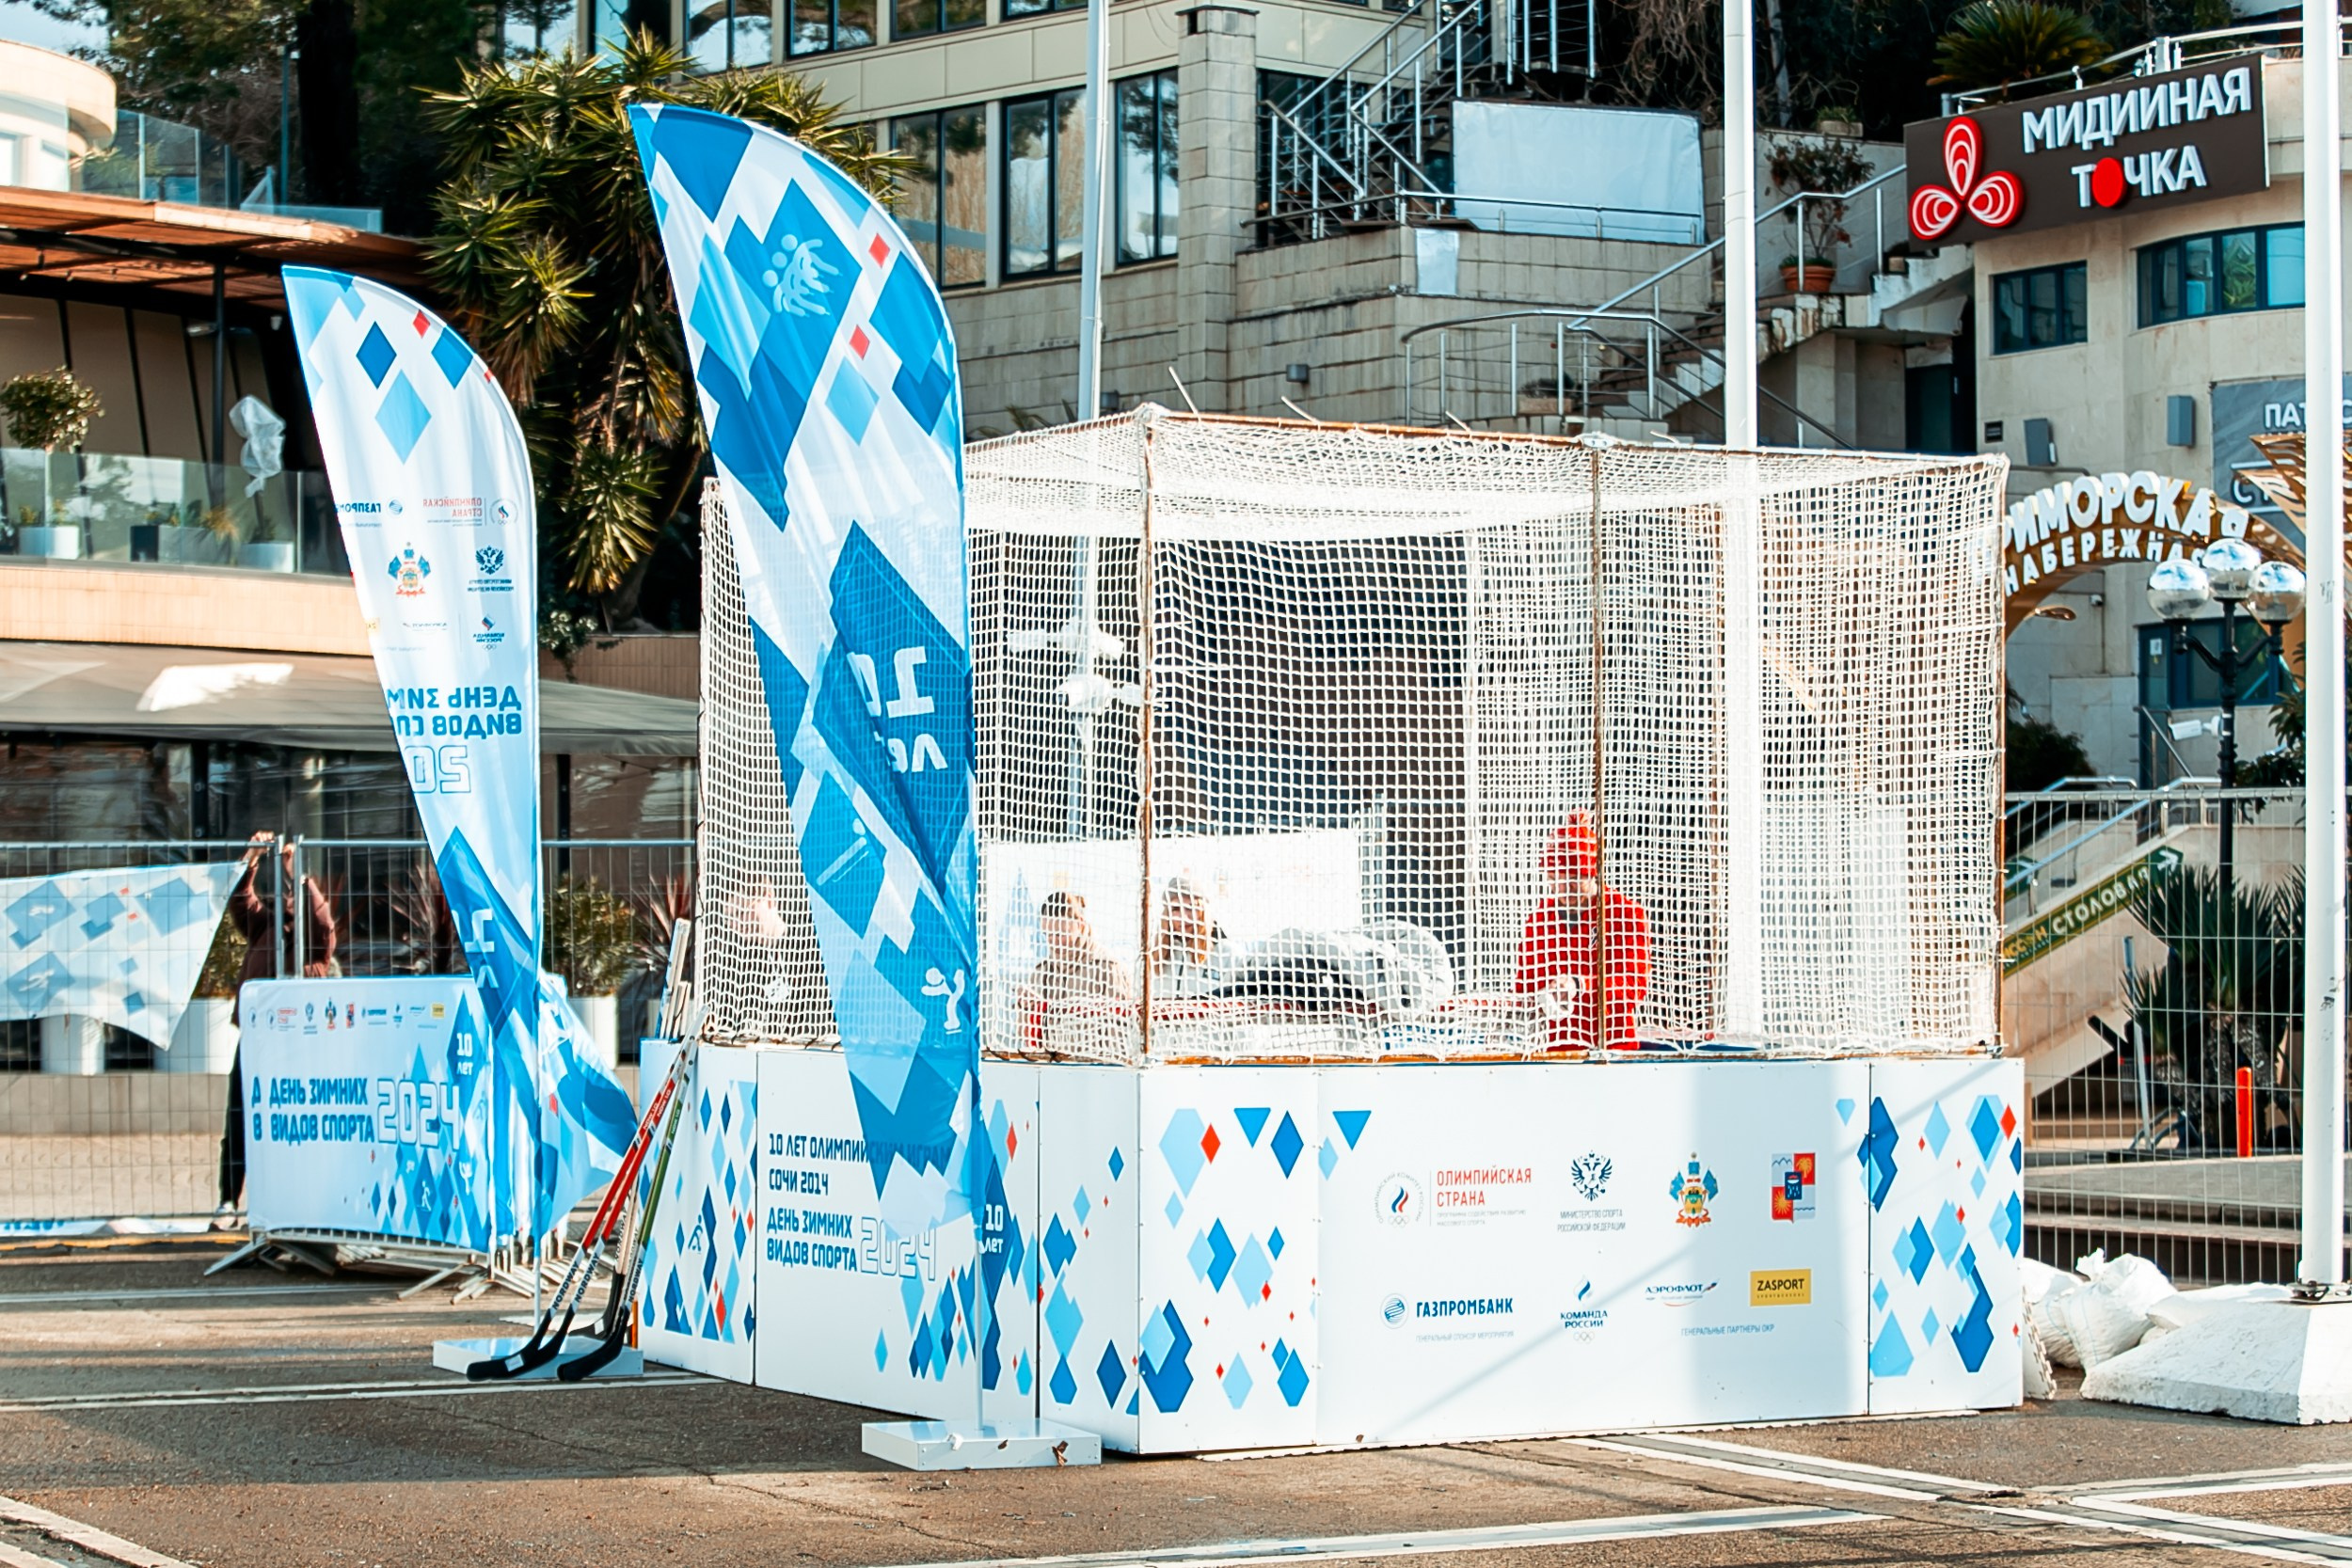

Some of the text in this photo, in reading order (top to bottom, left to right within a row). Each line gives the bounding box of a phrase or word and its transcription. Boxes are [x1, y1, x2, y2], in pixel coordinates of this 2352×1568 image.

[456, 1033, 472, 1057] 10
[269, 1078, 460, 1151] ДЕНЬ ЗИМНИХ 2024
[270, 1114, 374, 1146] ВИДОВ СПОРТА
[769, 1132, 783, 1155] 10
[786, 1134, 807, 1159] ЛЕТ
[769, 1168, 829, 1196] СОЧИ 2014
[1437, 1164, 1532, 1186] ОЛИМПИЙСКАЯ
[1437, 1191, 1486, 1207] СТРАНА
[767, 1207, 799, 1234] ДЕНЬ
[802, 1211, 852, 1239] ЗИМНИХ
[985, 1204, 1004, 1231] 10
[767, 1238, 857, 1272] ВИДОВ СПОРТА
[552, 1260, 579, 1310] NORDWAY
[575, 1252, 600, 1304] NORDWAY
[628, 1258, 644, 1303] NORDWAY
[1645, 1284, 1704, 1294] АЭРОФЛОТ
[1756, 1278, 1805, 1291] ZASPORT
[1416, 1297, 1514, 1318] ГАЗПРОМБАНК
[1560, 1310, 1608, 1320] КОМАНДА
[1565, 1320, 1603, 1329] РОССИИ
[1680, 1323, 1775, 1337] ГЕНЕРАЛЬНЫЕ ПАРТНЕРЫ ОКР
